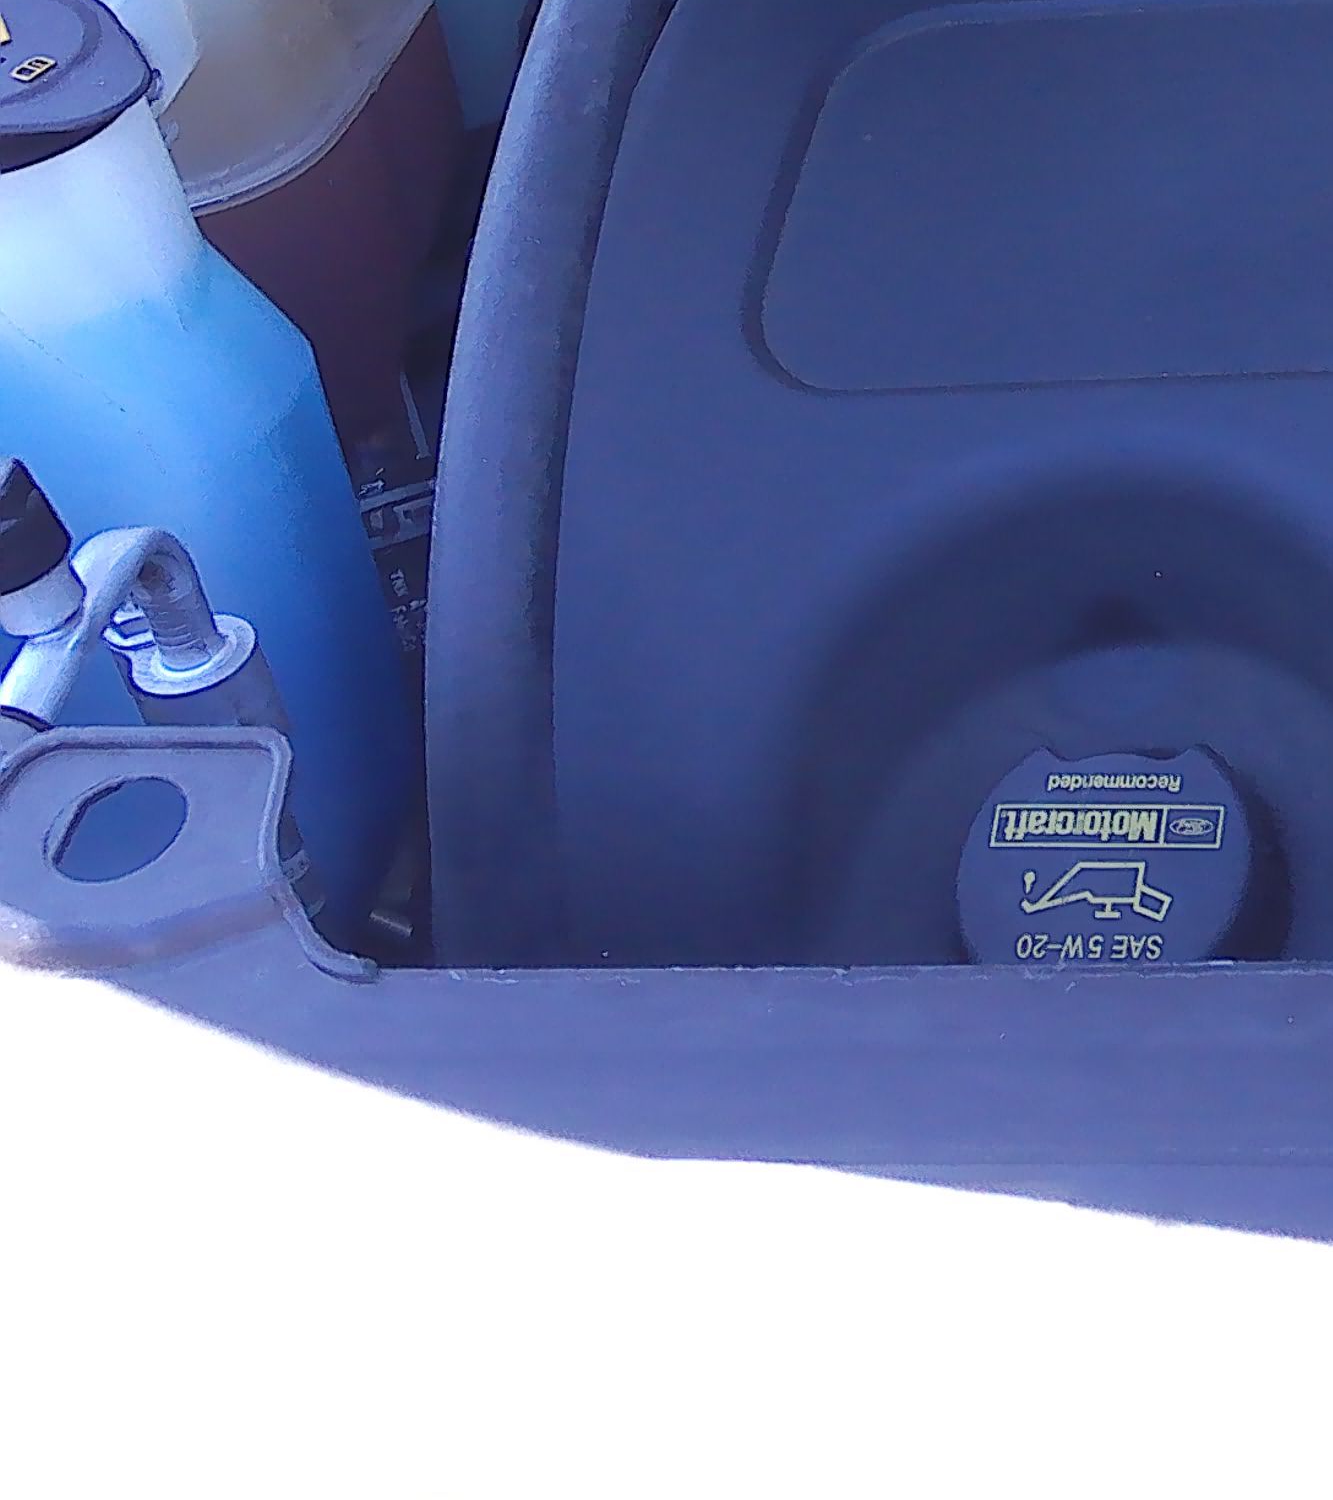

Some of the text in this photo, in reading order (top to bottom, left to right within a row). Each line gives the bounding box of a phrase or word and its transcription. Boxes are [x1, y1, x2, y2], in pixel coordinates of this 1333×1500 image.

[1046, 773, 1183, 794] Recommended
[1001, 808, 1160, 843] Motorcraft
[1015, 934, 1164, 960] SAE 5W-20
